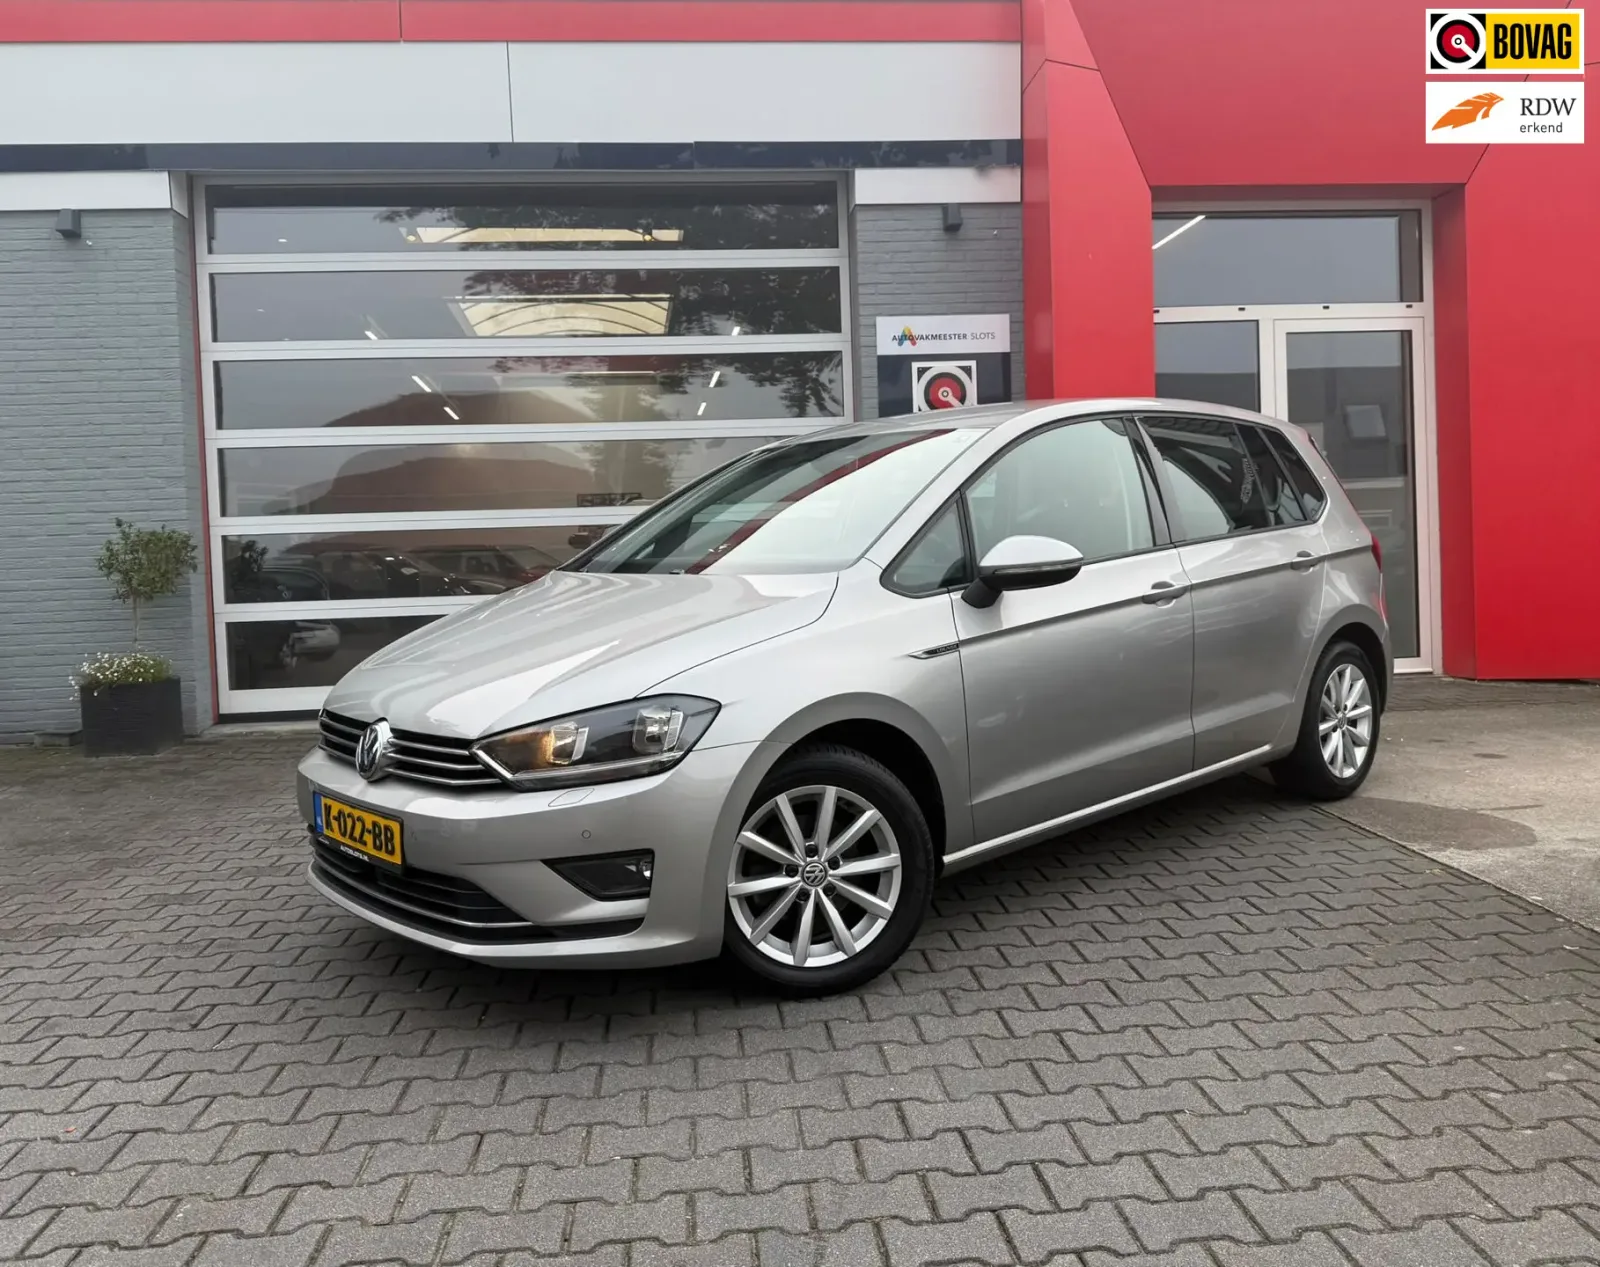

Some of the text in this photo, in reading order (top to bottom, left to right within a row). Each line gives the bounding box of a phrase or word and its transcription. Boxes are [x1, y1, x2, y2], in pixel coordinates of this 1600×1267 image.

[892, 332, 996, 342] AUTOVAKMEESTER SLOTS
[323, 803, 396, 856] K-022-BB
